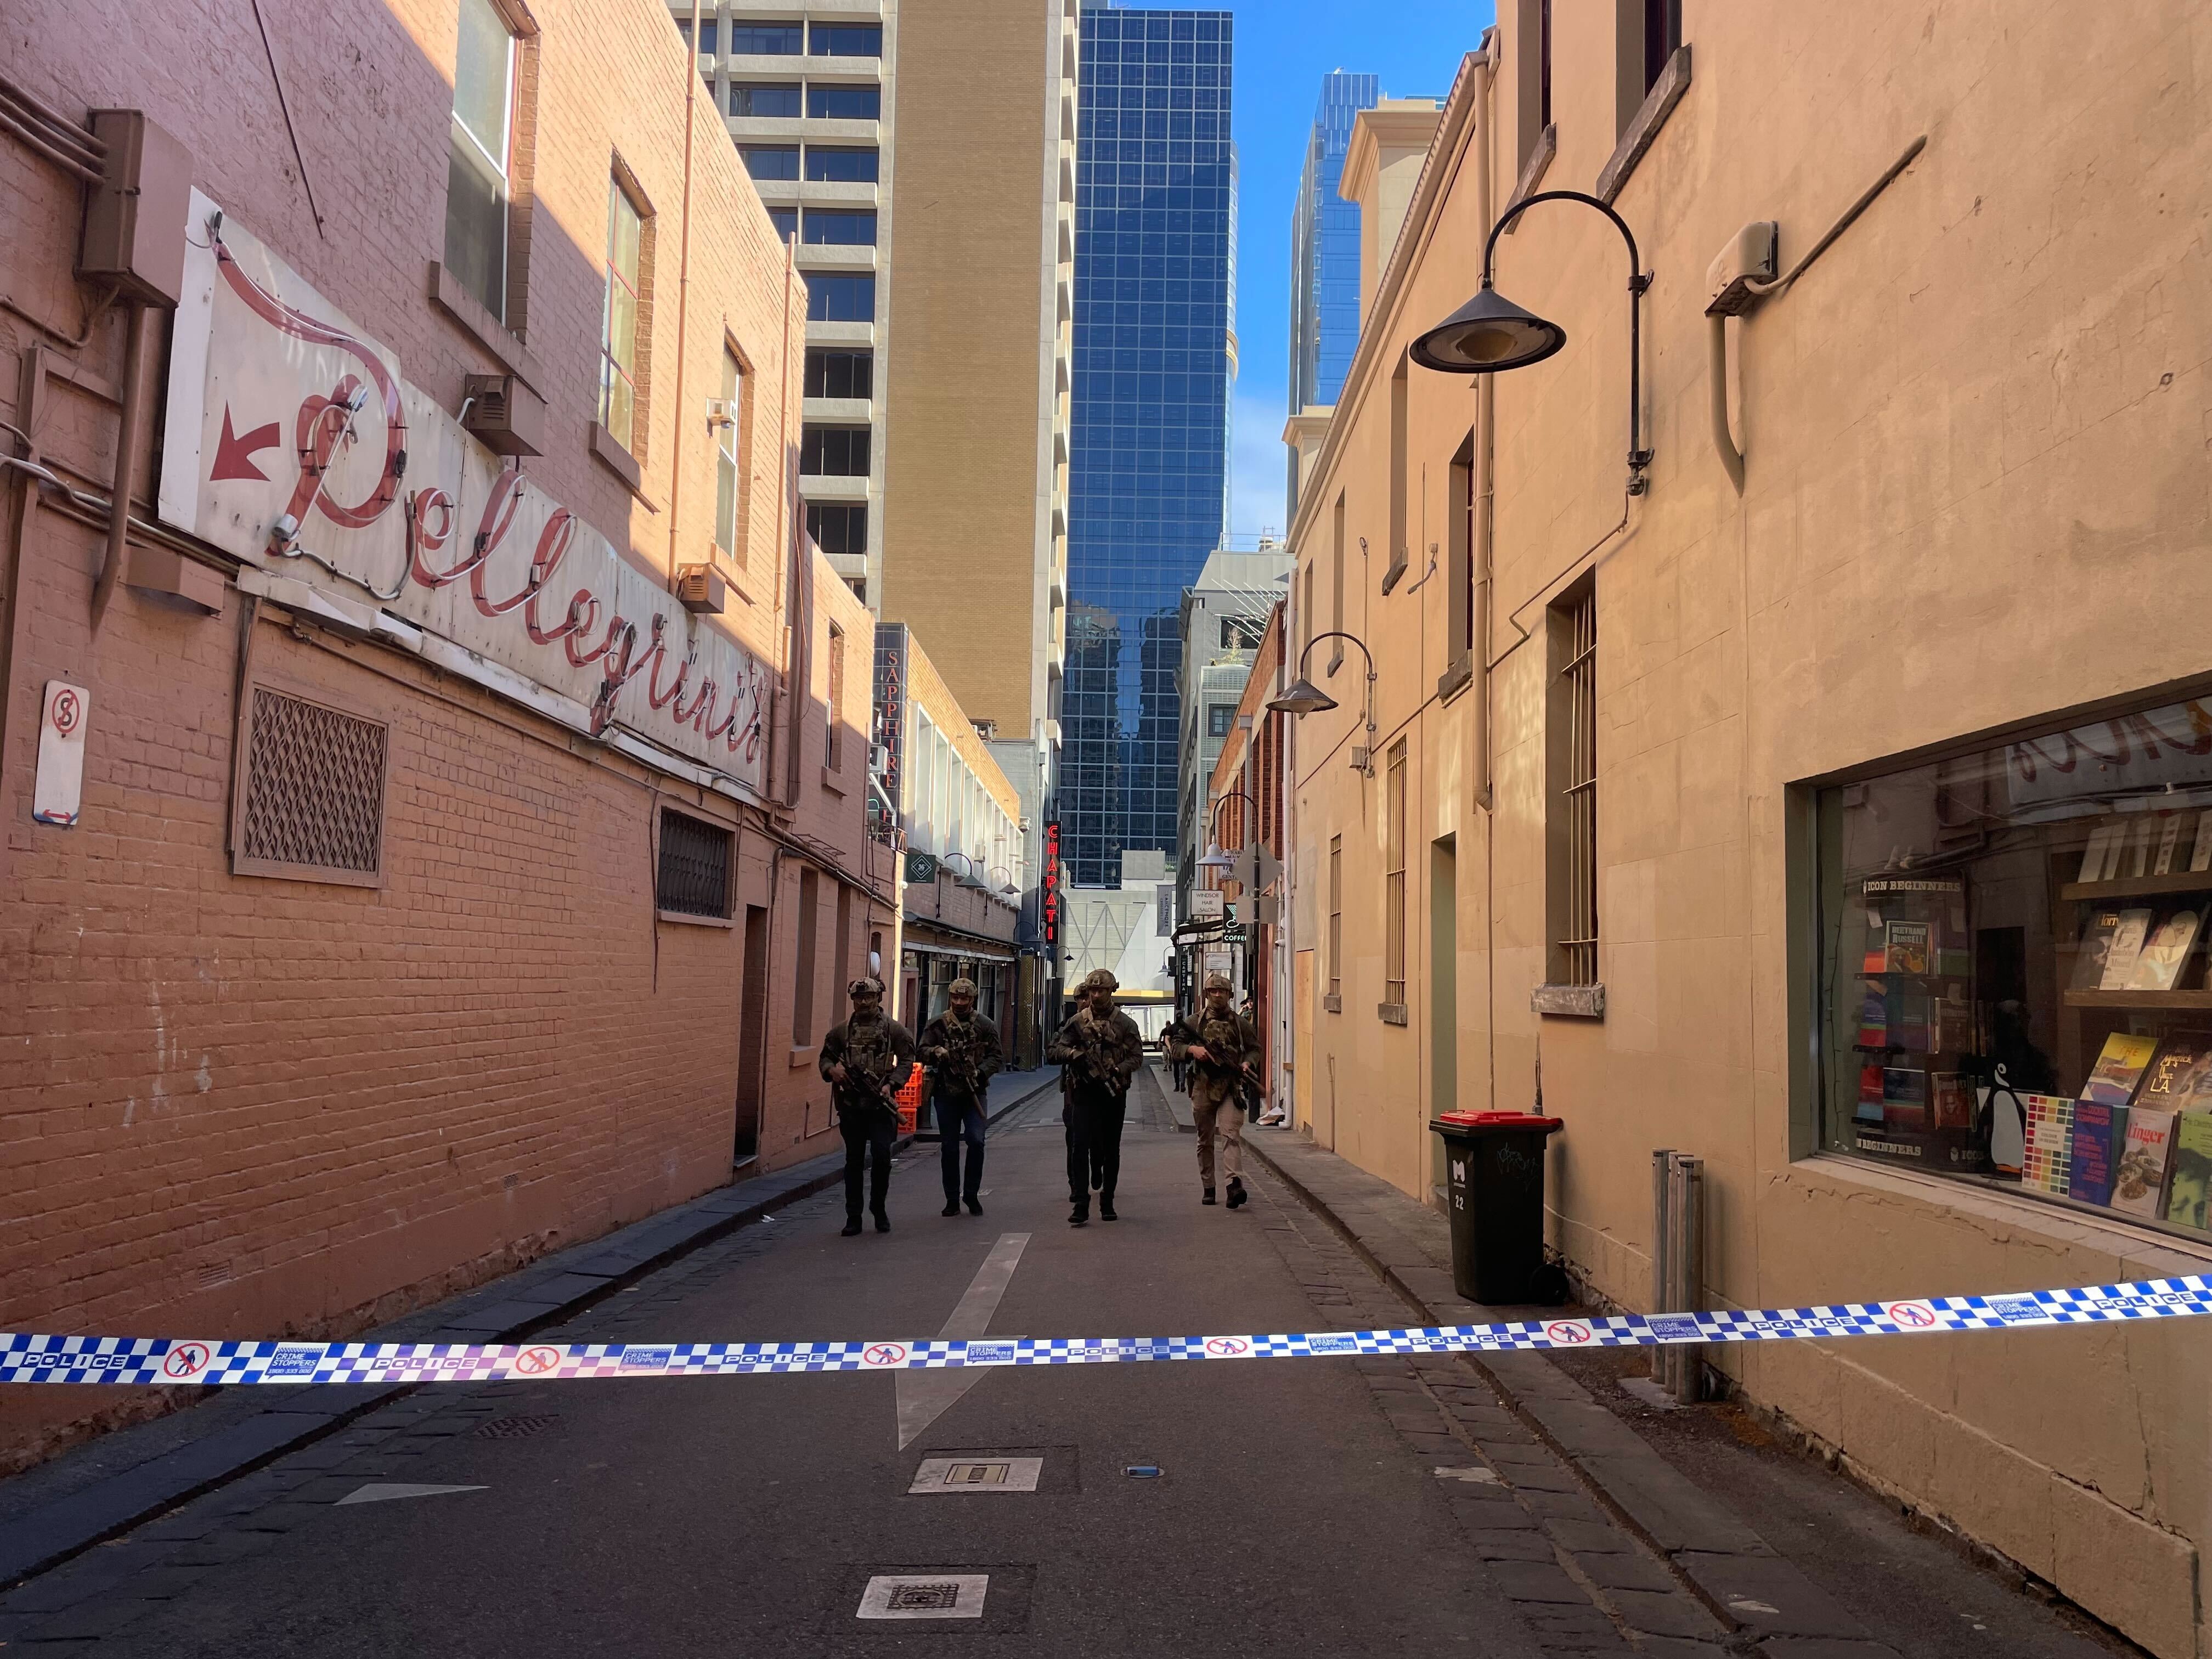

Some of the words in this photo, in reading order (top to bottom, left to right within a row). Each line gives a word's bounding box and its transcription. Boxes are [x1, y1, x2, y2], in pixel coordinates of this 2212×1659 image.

[885, 651, 899, 789] SAPPHIRE
[1046, 825, 1058, 940] CHAPATI
[1867, 881, 1887, 891] ICON
[1889, 881, 1961, 892] BEGINNERS
[1892, 926, 1926, 935] BERTRAND
[1893, 935, 1924, 944] RUSSELL
[2127, 1122, 2165, 1146] Linger
[1452, 1159, 1466, 1183] M
[1455, 1194, 1464, 1211] 22
[2096, 1292, 2196, 1309] POLICE
[1754, 1317, 1856, 1330] POLICE
[1412, 1334, 1512, 1345] POLICE
[1069, 1346, 1169, 1356] POLICE
[24, 1354, 127, 1368] POLICE
[374, 1359, 478, 1368] POLICE
[724, 1354, 825, 1364] POLICE
